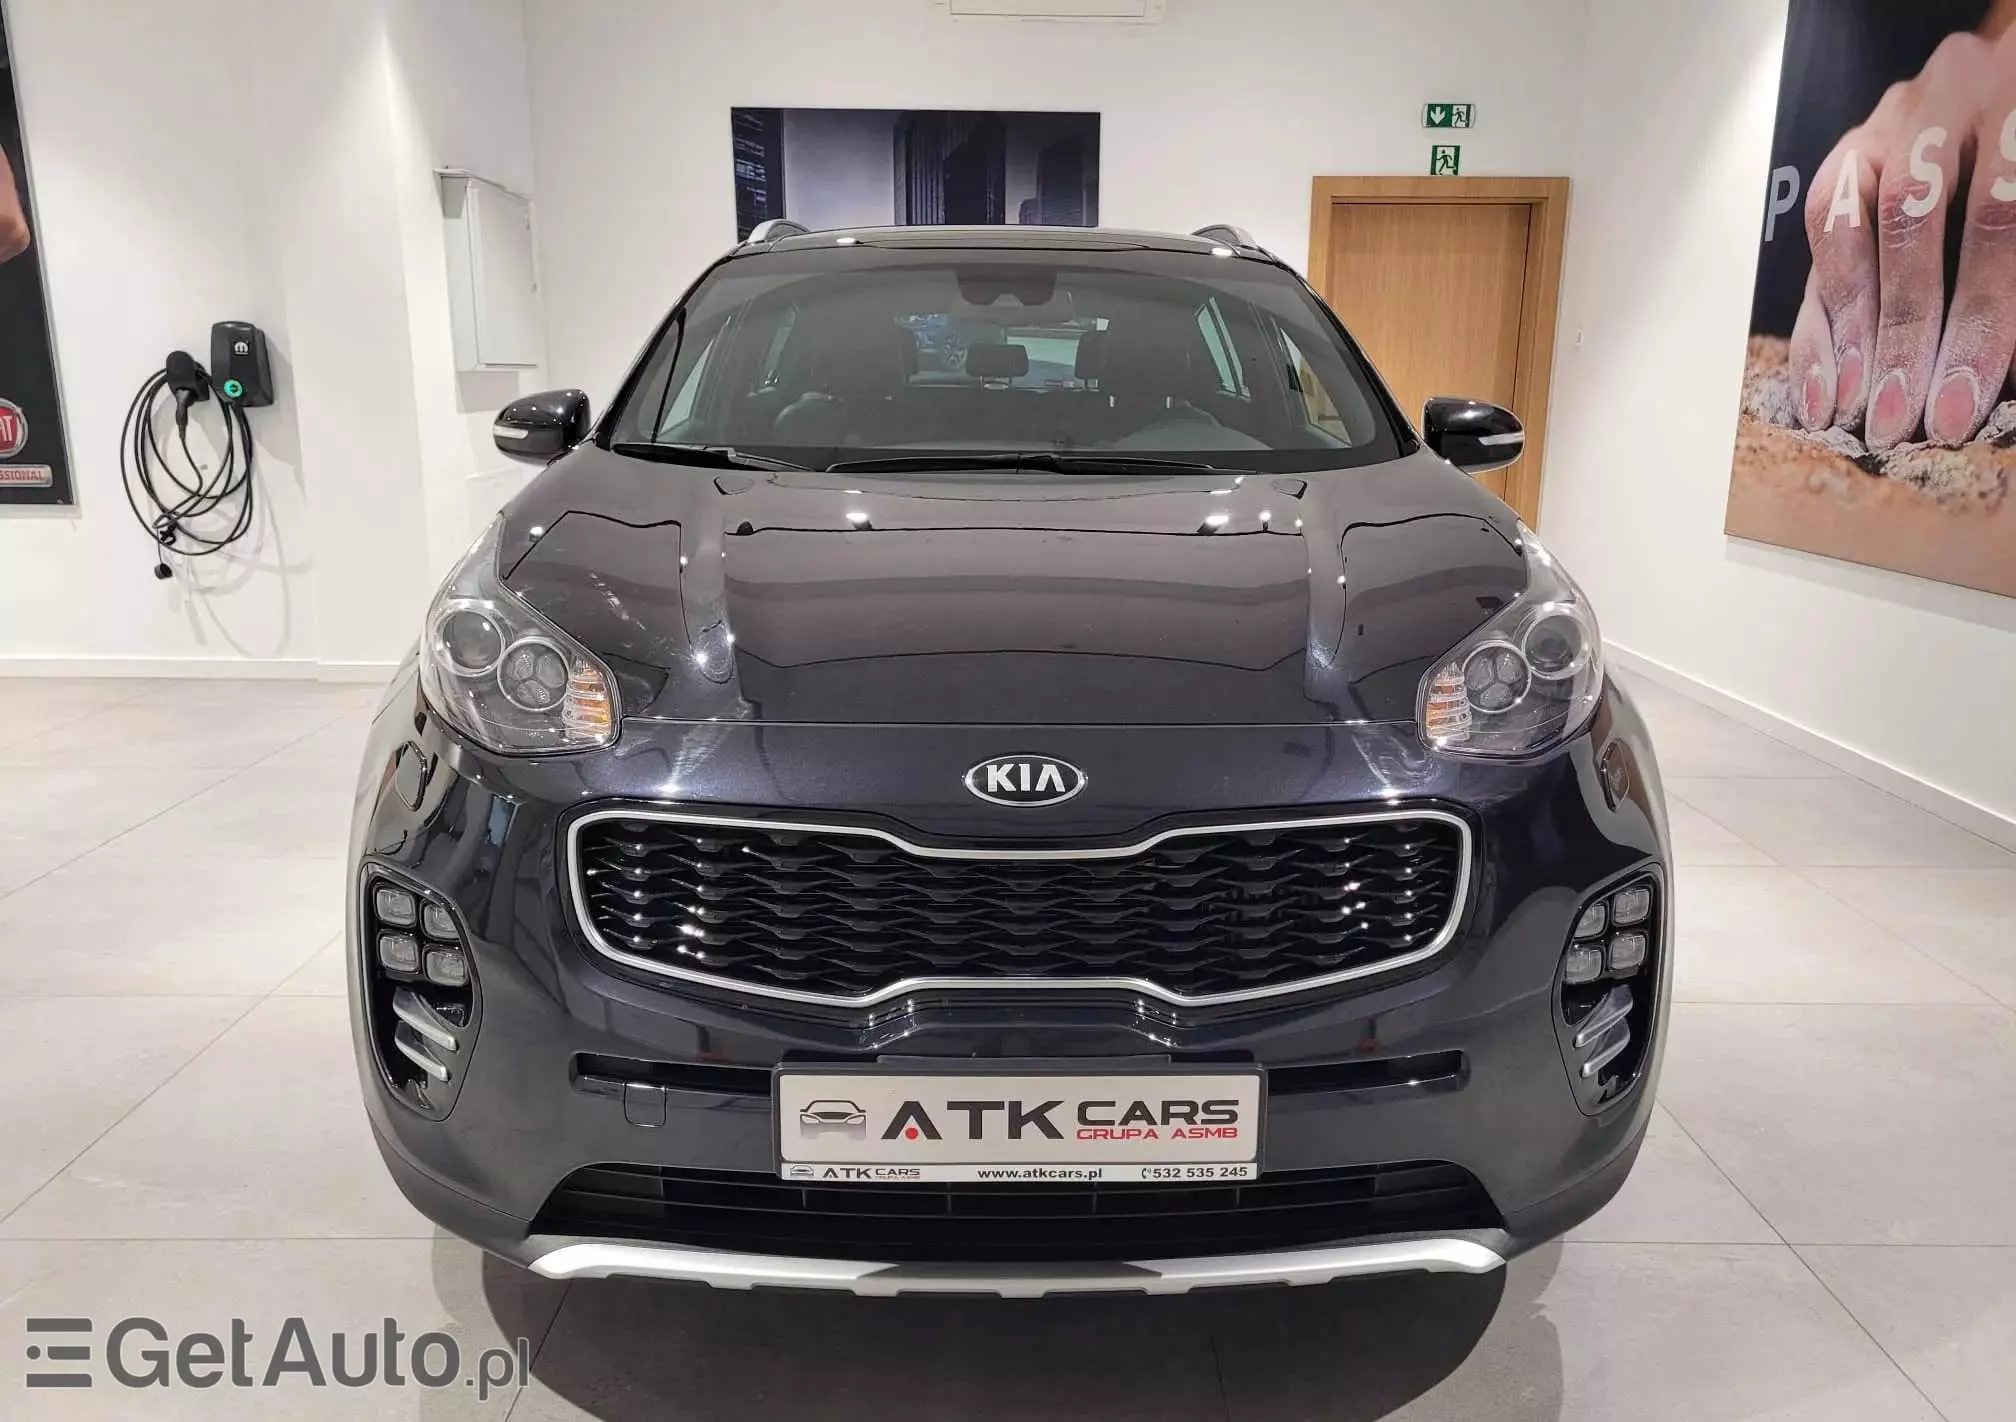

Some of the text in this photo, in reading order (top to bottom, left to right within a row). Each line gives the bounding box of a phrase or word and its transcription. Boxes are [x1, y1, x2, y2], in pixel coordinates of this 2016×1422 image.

[986, 763, 1066, 793] KIA
[880, 1100, 1240, 1141] ATK CARS
[1076, 1127, 1239, 1140] GRUPA ASMB
[822, 1167, 921, 1179] ATK CARS
[977, 1167, 1103, 1181] www.atkcars.pl
[1152, 1166, 1248, 1179] 532 535 245
